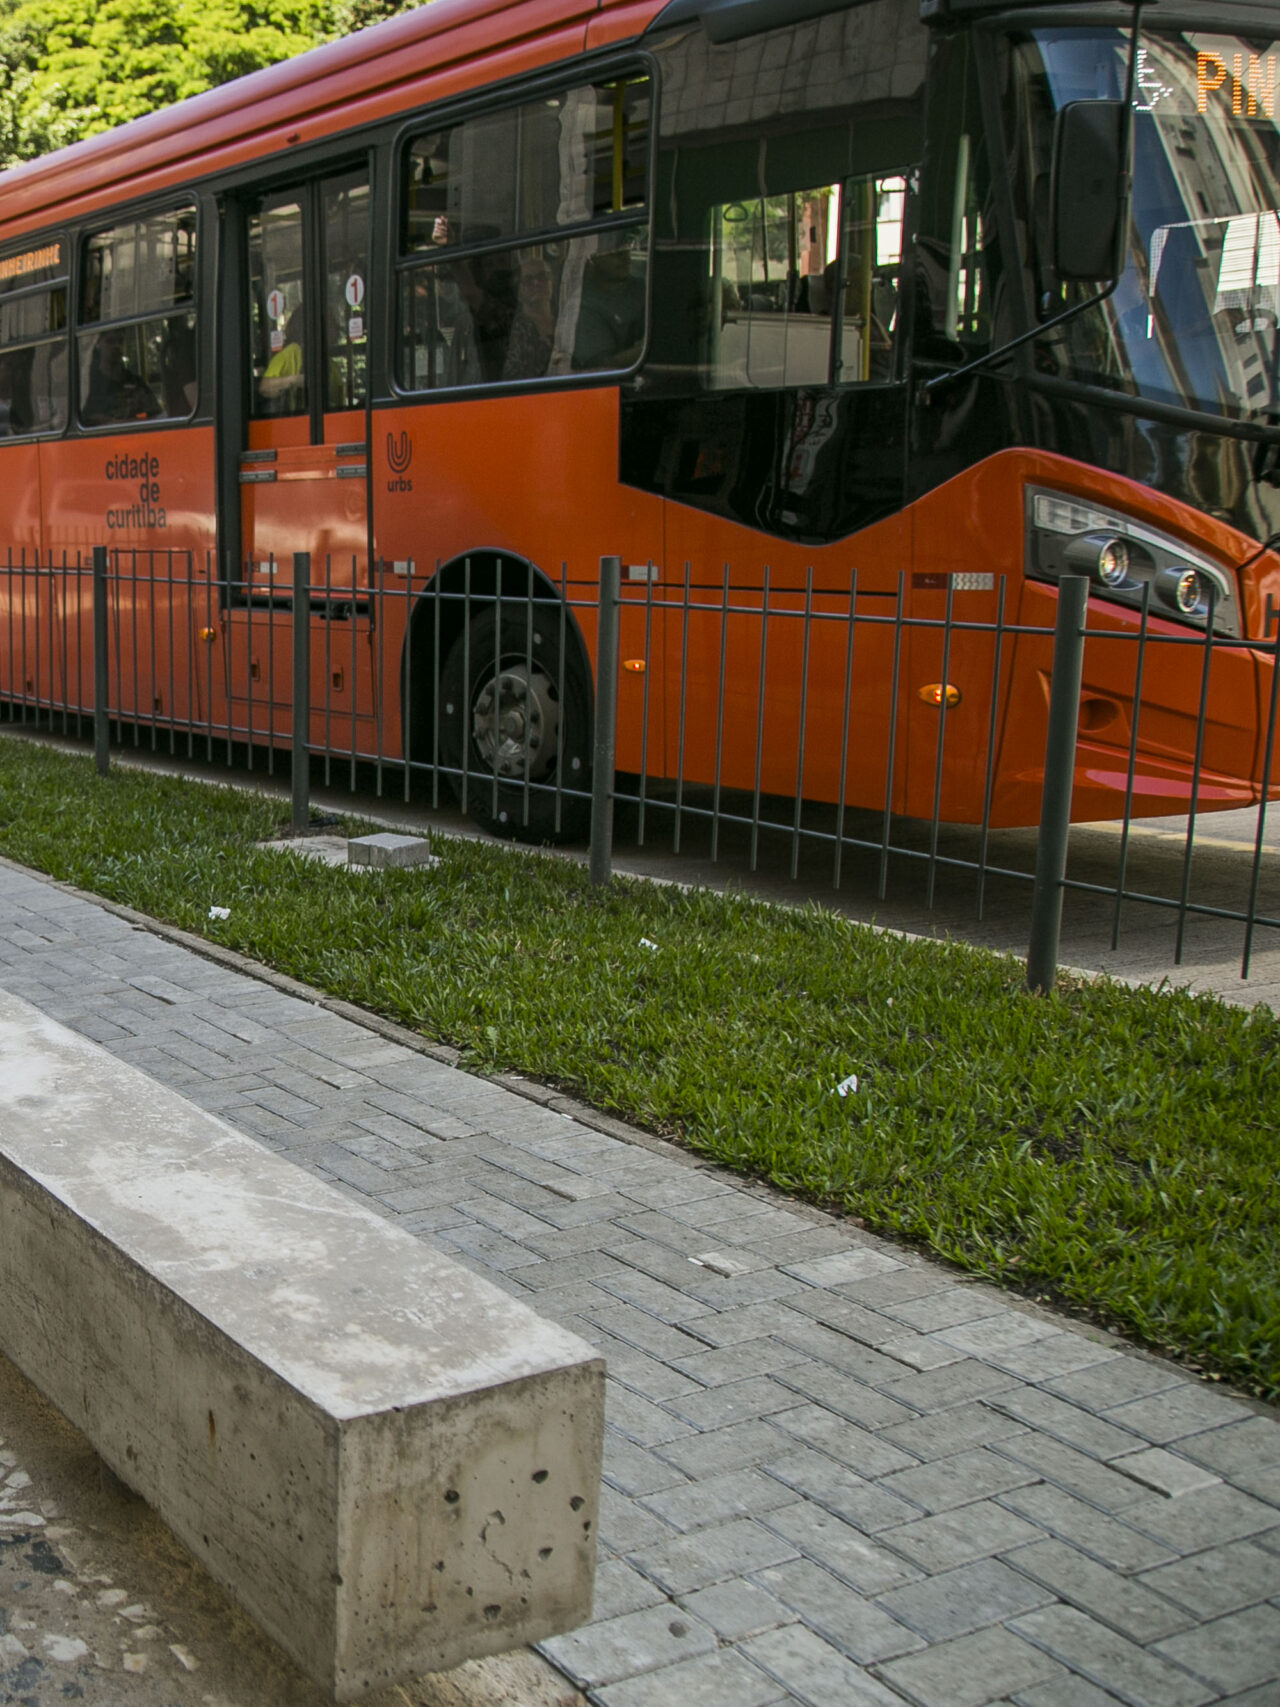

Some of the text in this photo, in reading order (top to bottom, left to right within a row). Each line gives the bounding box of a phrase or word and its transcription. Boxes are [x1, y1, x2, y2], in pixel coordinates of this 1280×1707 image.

[350, 277, 359, 304] 1
[270, 293, 279, 317] 1
[105, 451, 160, 480] cidade
[140, 481, 160, 503] de
[387, 475, 413, 492] urbs
[106, 502, 167, 529] curitiba
